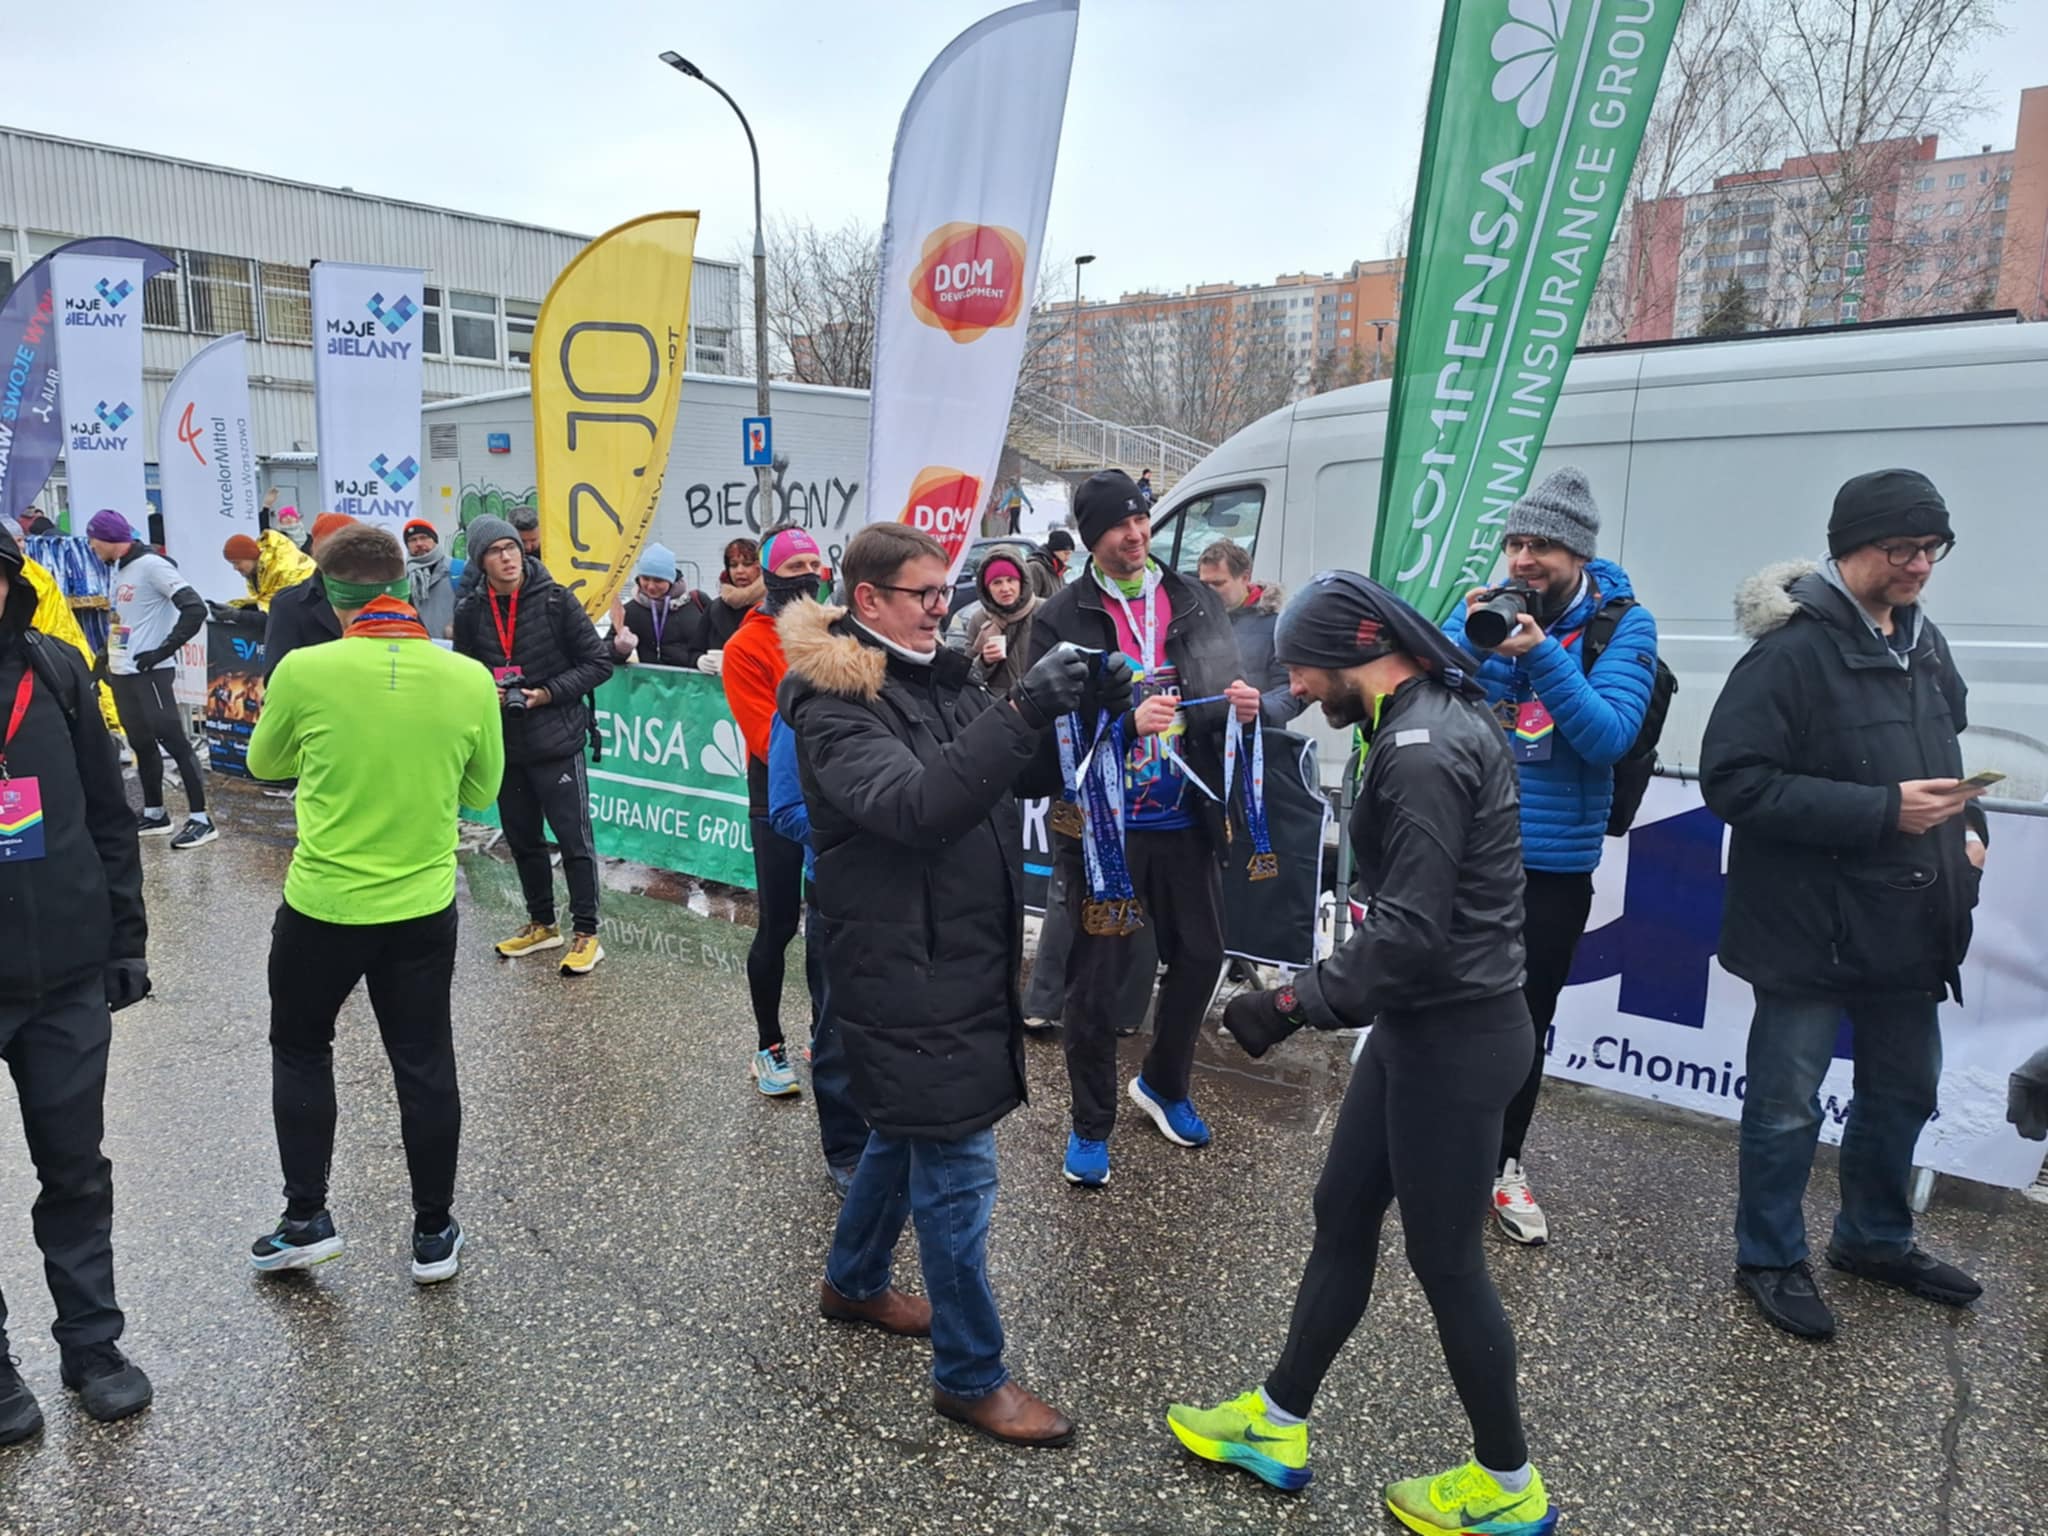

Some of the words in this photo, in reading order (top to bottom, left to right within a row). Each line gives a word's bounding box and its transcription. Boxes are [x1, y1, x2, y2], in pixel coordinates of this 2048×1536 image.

[933, 258, 994, 292] DOM
[326, 319, 376, 338] MOJE
[3, 343, 36, 421] SWOJE
[1455, 434, 1535, 586] VIENNA
[1507, 144, 1616, 419] INSURANCE
[210, 417, 235, 520] ArcelorMittal
[914, 505, 972, 533] DOM
